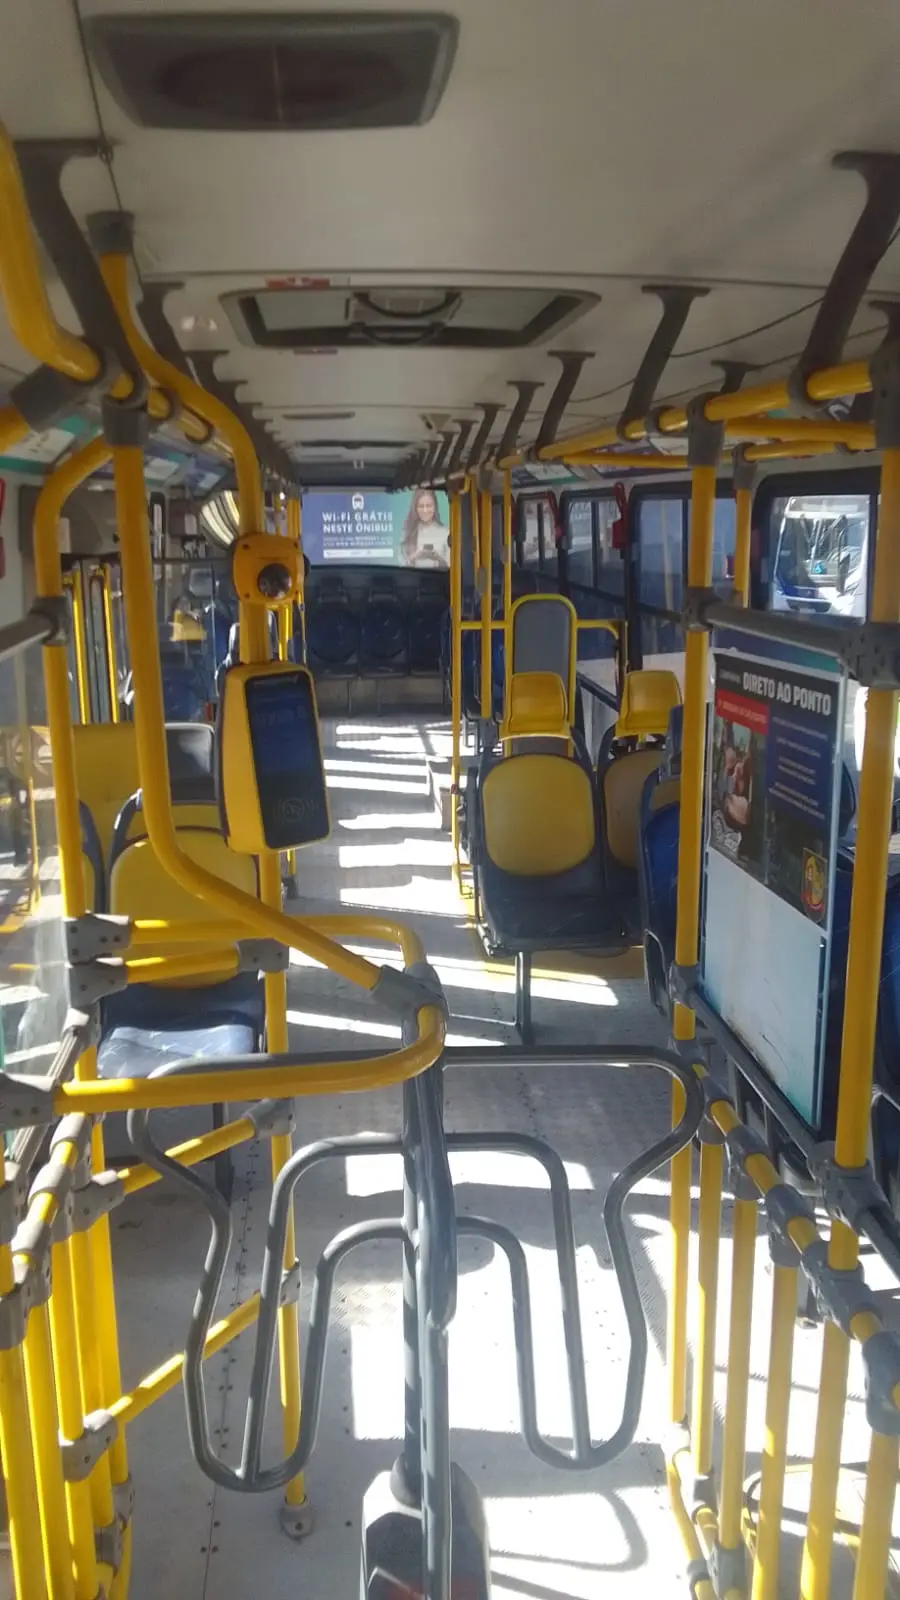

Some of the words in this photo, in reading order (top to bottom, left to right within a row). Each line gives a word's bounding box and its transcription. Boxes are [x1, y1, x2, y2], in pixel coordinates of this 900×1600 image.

[322, 511, 351, 521] WI-FI
[355, 510, 393, 521] GRÁTIS
[323, 523, 353, 533] NESTE
[356, 522, 394, 533] ÔNIBUS
[743, 672, 775, 698] DIRETO
[776, 681, 792, 703] AO
[793, 685, 831, 716] PONTO
